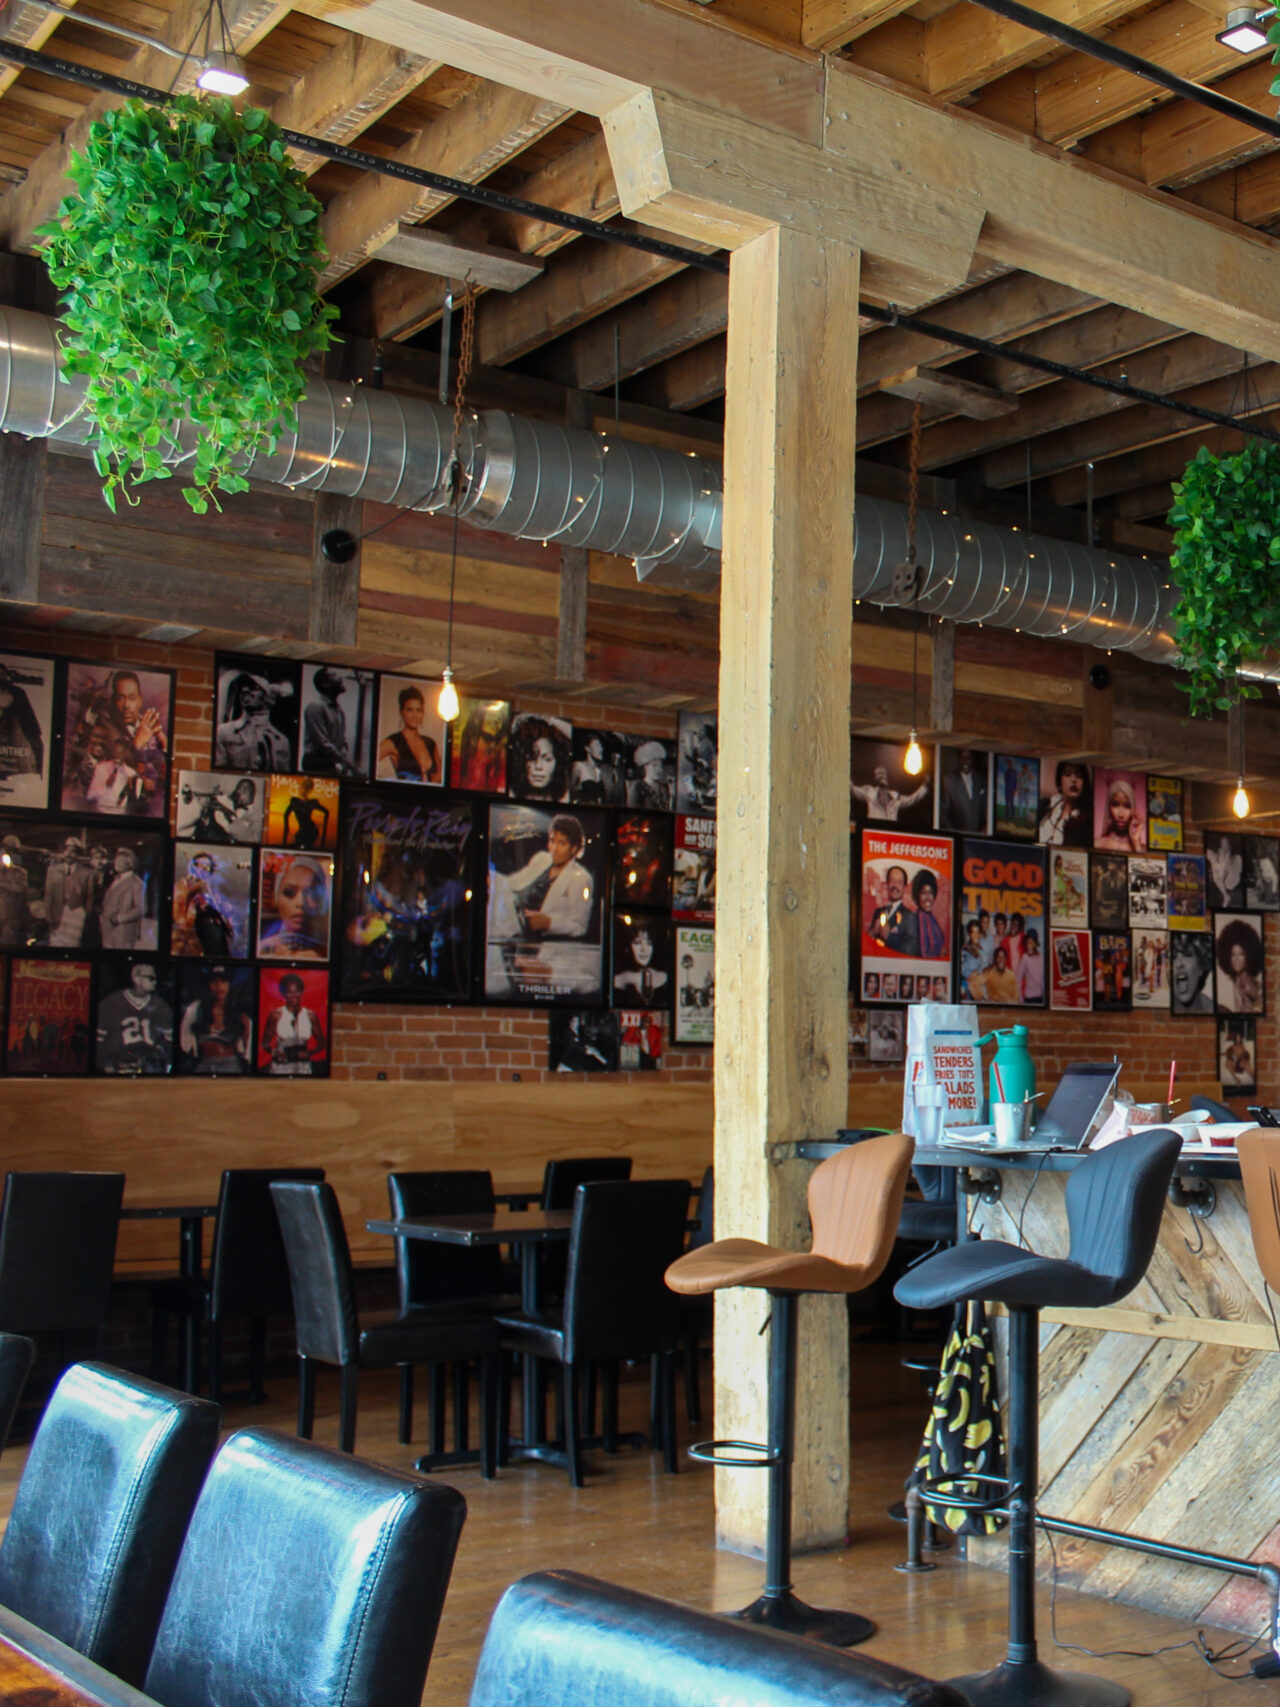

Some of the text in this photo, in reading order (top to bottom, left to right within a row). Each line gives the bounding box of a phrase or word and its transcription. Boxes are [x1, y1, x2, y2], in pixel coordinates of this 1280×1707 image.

[347, 801, 424, 846] Purple
[684, 816, 717, 834] SANF
[867, 839, 949, 861] THE JEFFERSONS
[962, 857, 1043, 889] GOOD
[962, 886, 1043, 917] TIMES
[12, 982, 89, 1011] LEGACY
[518, 984, 572, 995] THRILLER
[121, 1016, 155, 1046] 21
[933, 1045, 973, 1055] SANDWICHES
[933, 1056, 975, 1068] TENDERS
[934, 1070, 955, 1079] FRIES
[958, 1070, 975, 1080] TOTS
[936, 1081, 975, 1095] ALADS
[948, 1097, 977, 1110] MORE!
